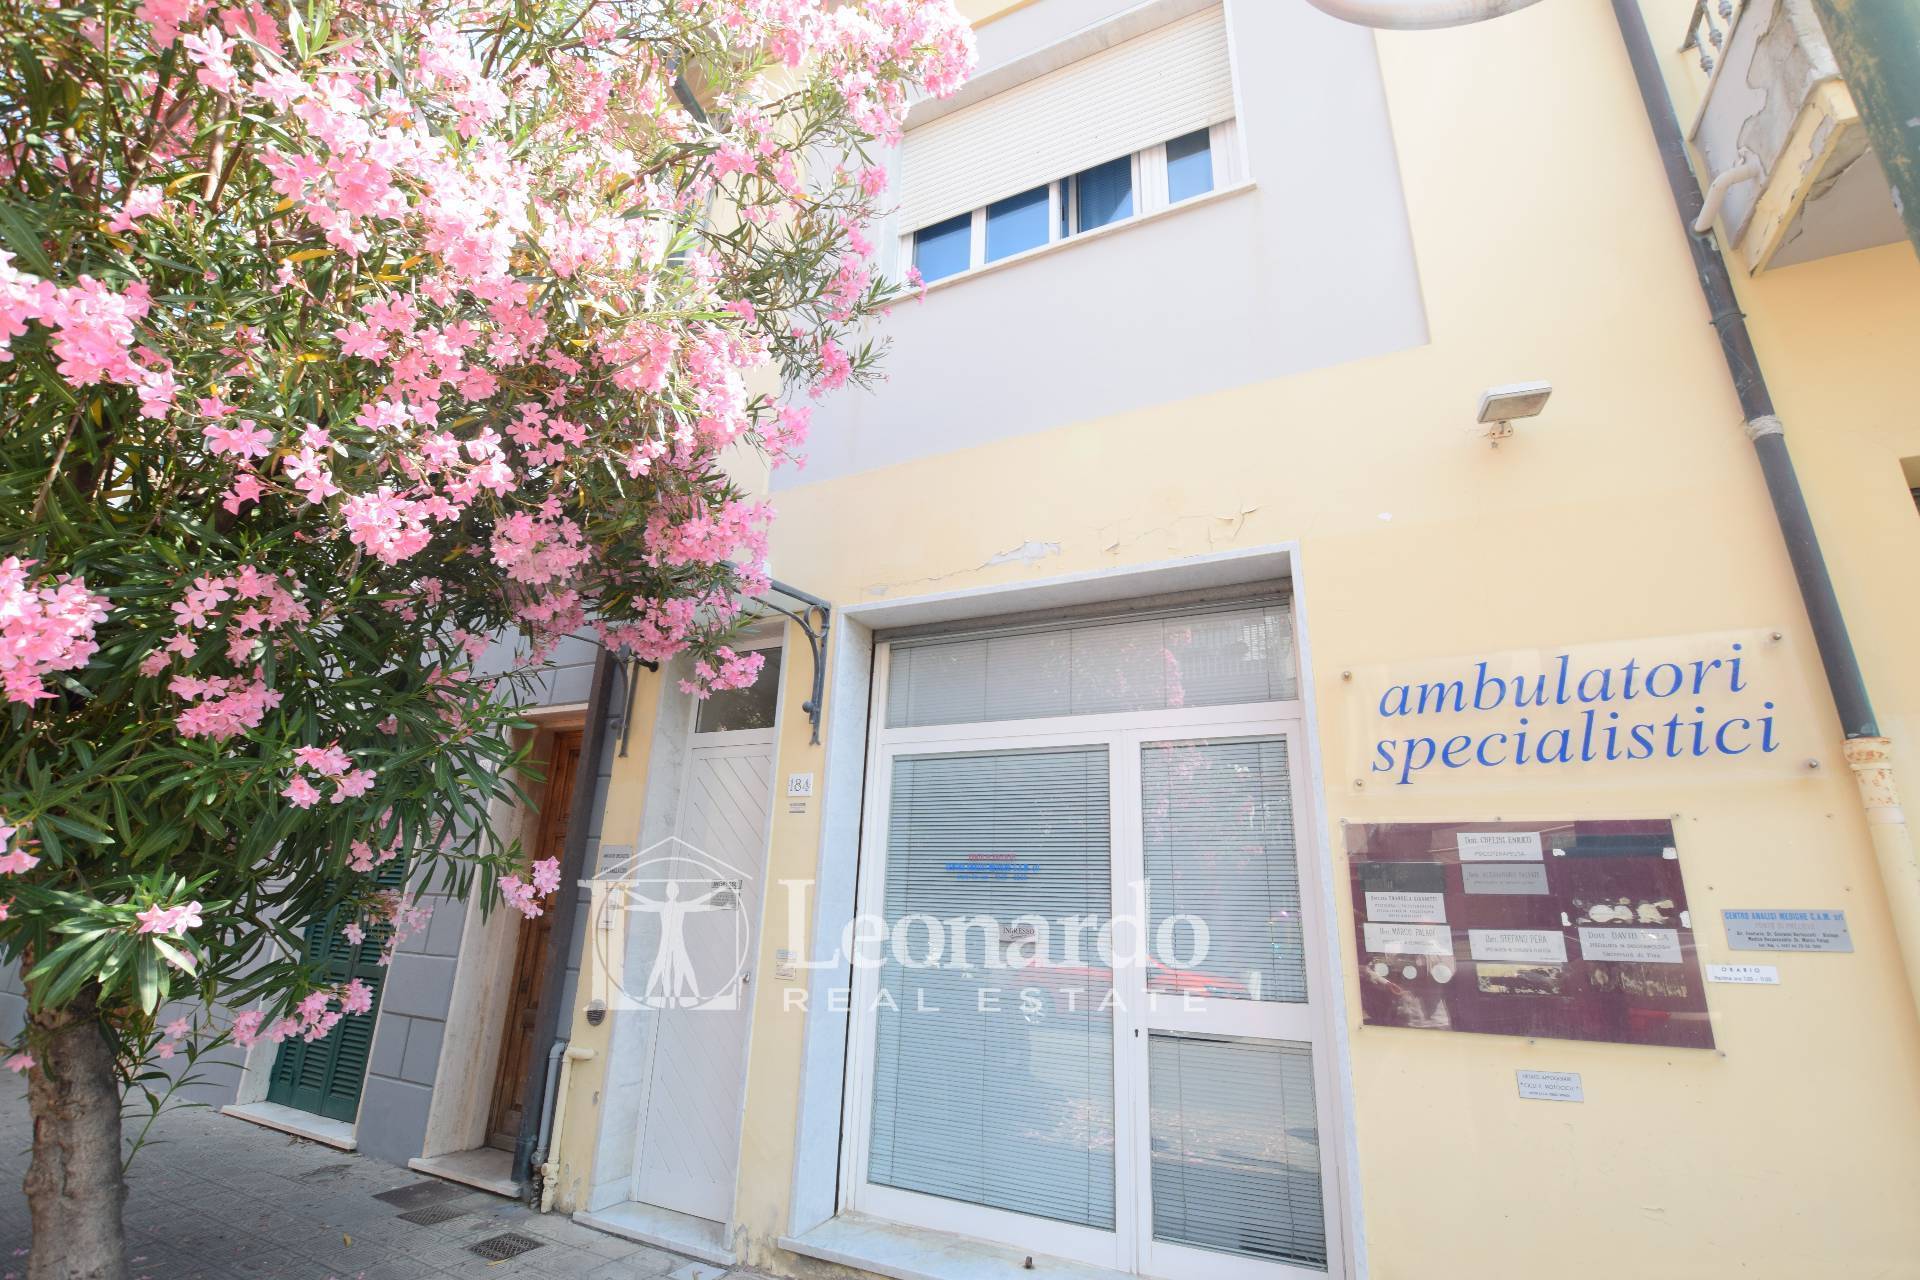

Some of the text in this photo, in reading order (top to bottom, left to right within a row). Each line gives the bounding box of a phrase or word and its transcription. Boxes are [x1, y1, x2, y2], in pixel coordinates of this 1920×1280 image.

[1379, 643, 1748, 718] ambulatori
[1372, 701, 1781, 785] specialistici
[788, 777, 811, 792] 184
[1723, 911, 1750, 920] CENTRO
[1751, 911, 1777, 921] ANALISI
[1002, 926, 1035, 936] INGRESSO
